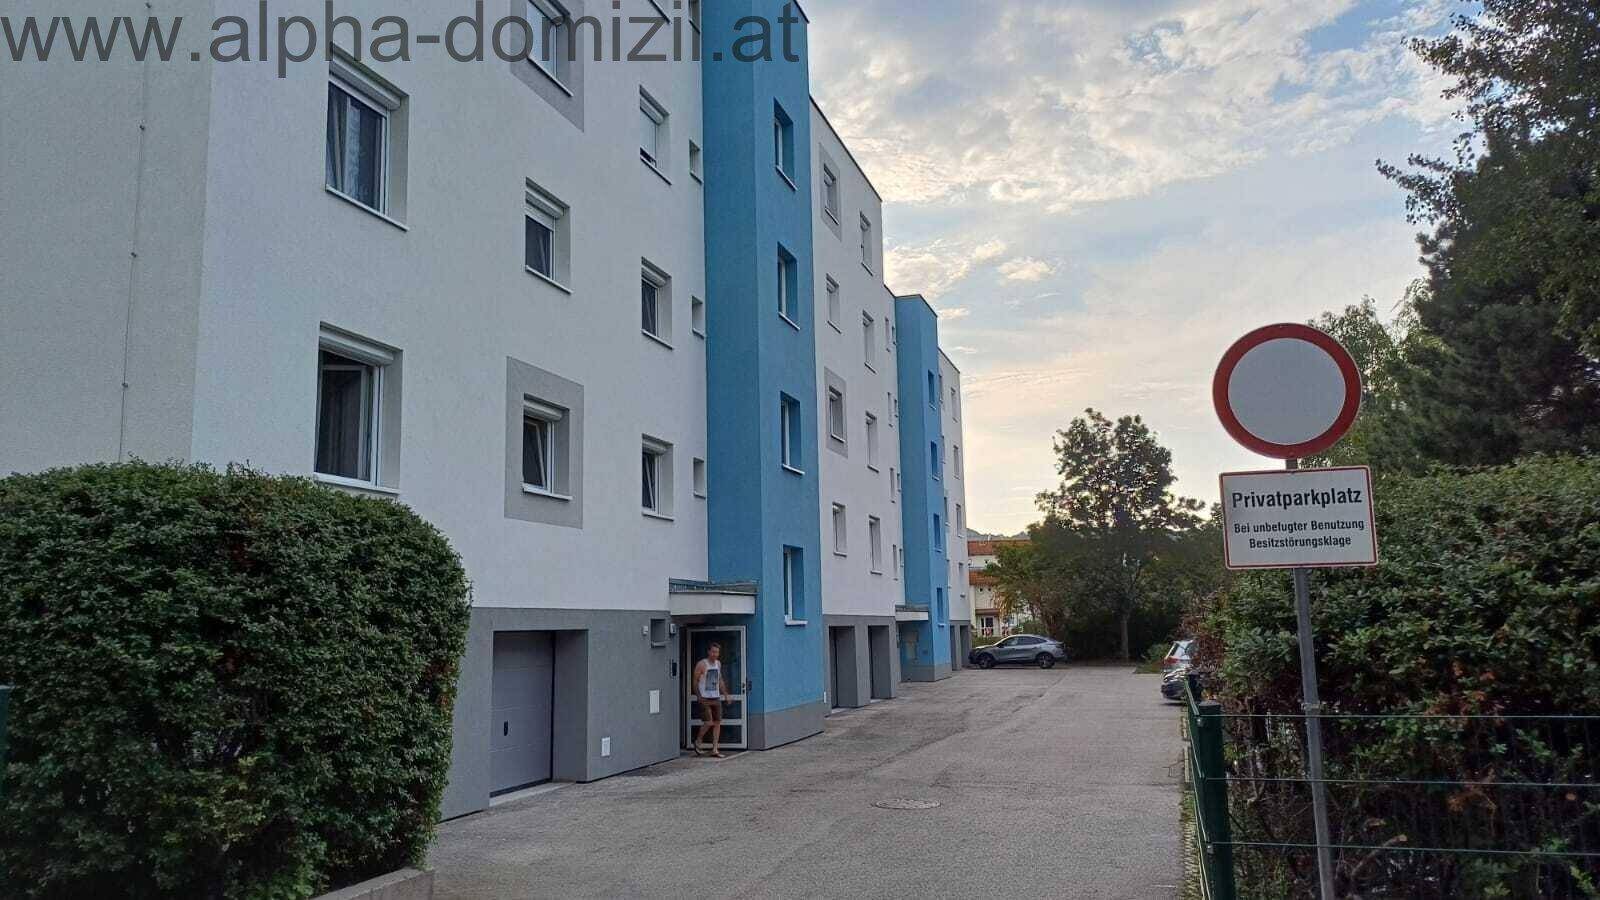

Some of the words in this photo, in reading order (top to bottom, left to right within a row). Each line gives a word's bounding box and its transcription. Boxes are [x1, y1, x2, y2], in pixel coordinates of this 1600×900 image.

[1231, 487, 1363, 510] Privatparkplatz
[1233, 522, 1251, 534] Bei
[1253, 521, 1308, 534] unbefugter
[1311, 519, 1365, 532] Benutzung
[1249, 536, 1352, 549] Besitzstörungsklage
